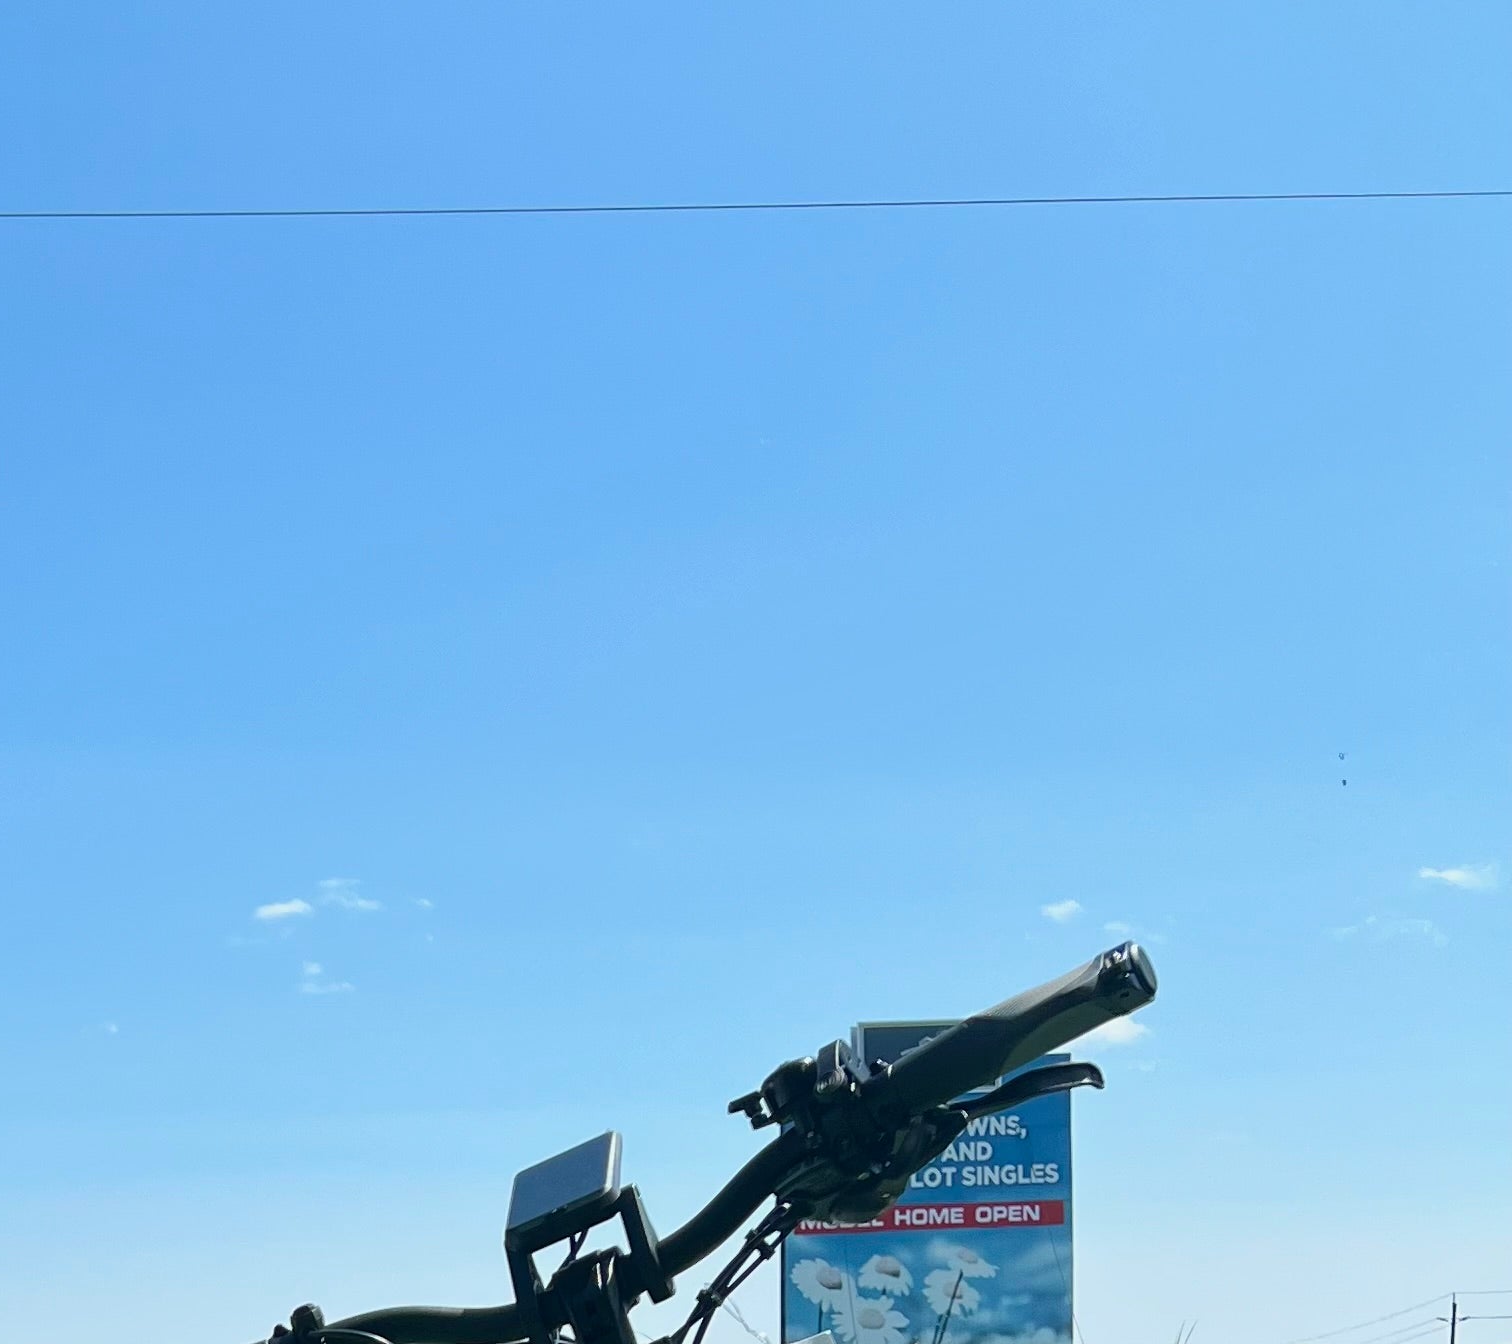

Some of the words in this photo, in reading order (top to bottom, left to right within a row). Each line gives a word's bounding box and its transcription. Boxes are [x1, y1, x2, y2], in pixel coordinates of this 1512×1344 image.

[958, 1115, 1027, 1139] WNS,
[941, 1141, 993, 1161] AND
[910, 1167, 956, 1188] LOT
[961, 1163, 1059, 1186] SINGLES
[894, 1207, 964, 1226] HOME
[975, 1204, 1040, 1223] OPEN
